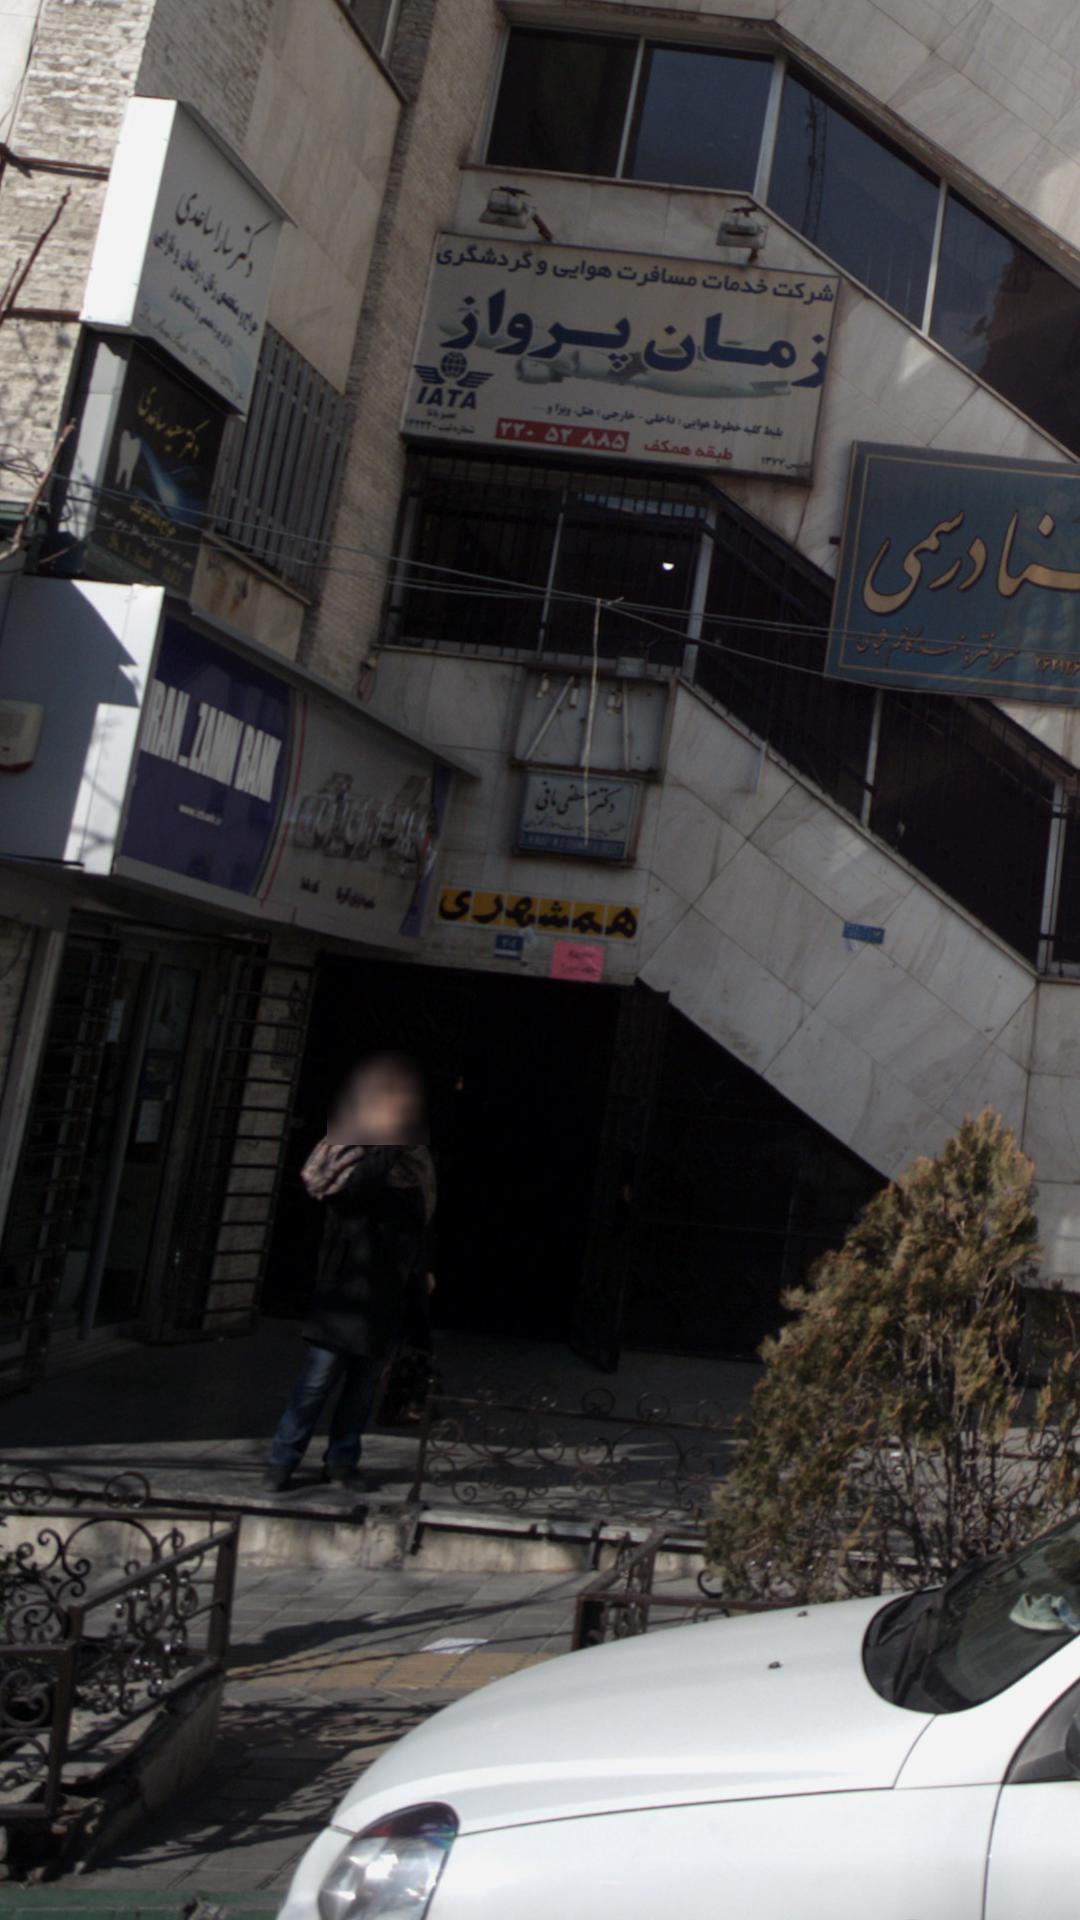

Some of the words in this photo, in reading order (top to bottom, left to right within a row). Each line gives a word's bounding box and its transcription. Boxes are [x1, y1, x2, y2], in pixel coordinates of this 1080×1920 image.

[226, 220, 271, 278] دکتر
[436, 245, 533, 272] گردشگری
[536, 260, 548, 275] و
[552, 260, 612, 281] هوایی
[617, 265, 697, 286] مسافرت
[702, 275, 768, 294] خدمات
[772, 283, 834, 305] شرکت
[440, 289, 631, 372] پرواز
[643, 312, 827, 388] زمان
[416, 386, 477, 410] IATA
[544, 426, 573, 445] ۵۲
[582, 430, 625, 450] ۸۸۵
[644, 439, 691, 457] همکف
[695, 446, 733, 462] طبقه
[864, 510, 965, 615] رسمی
[588, 786, 622, 816] دکتر
[438, 890, 638, 938] همشهری
